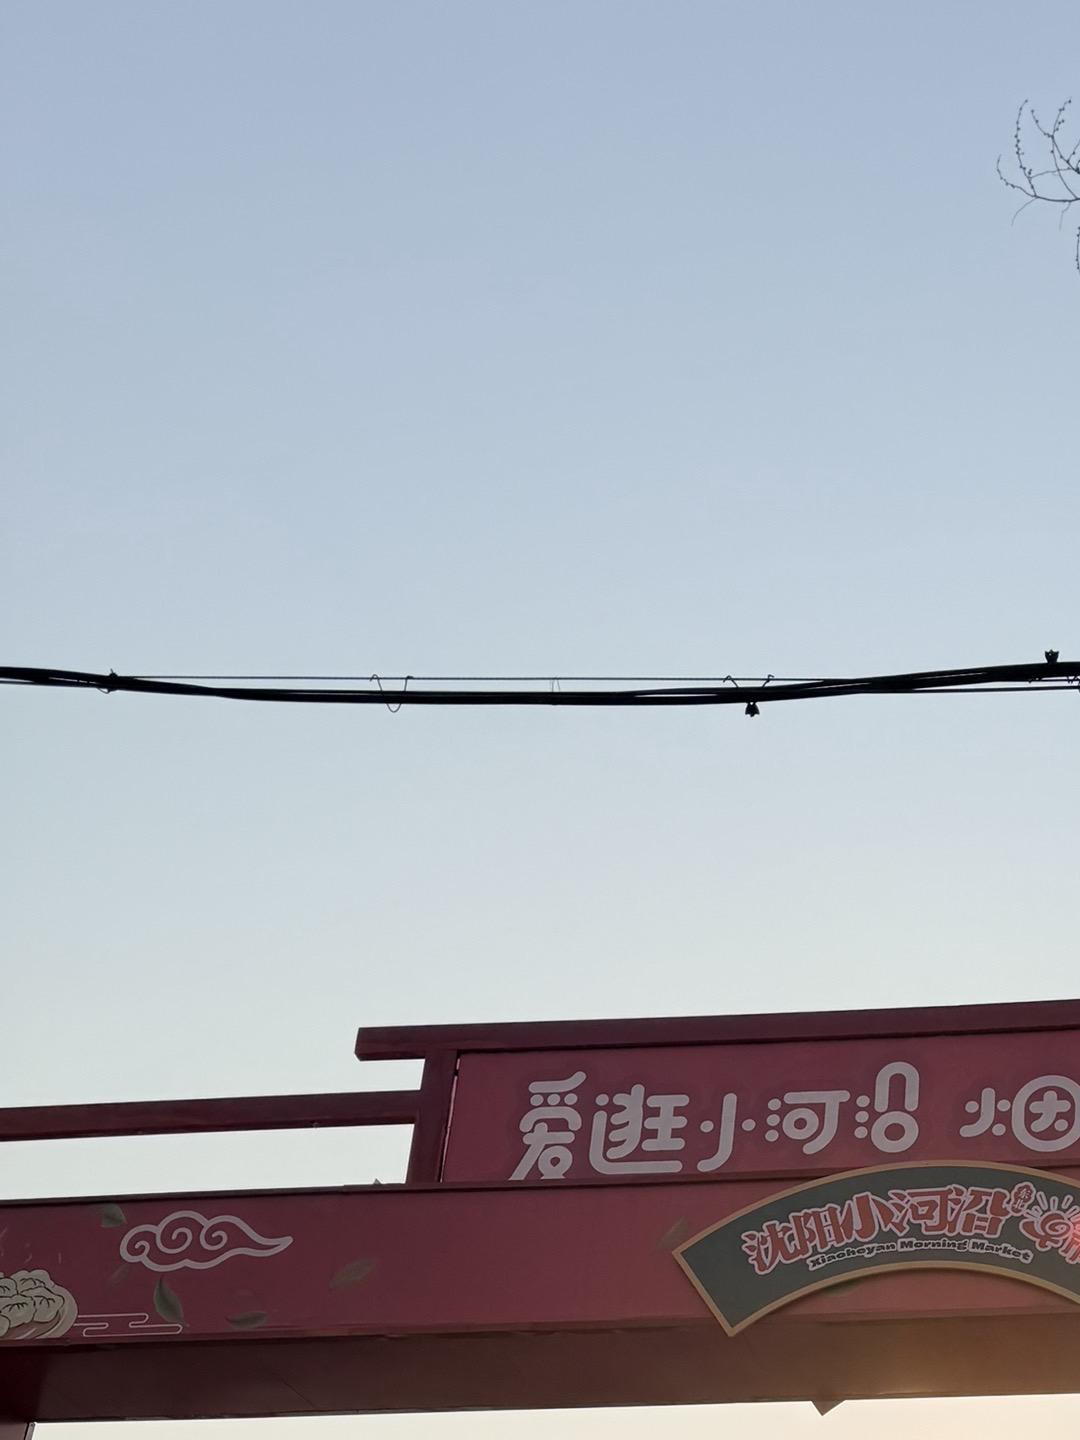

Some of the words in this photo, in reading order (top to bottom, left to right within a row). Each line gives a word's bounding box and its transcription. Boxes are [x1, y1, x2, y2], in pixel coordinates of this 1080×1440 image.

[509, 1061, 920, 1181] 爱逛小河沿
[899, 1239, 968, 1251] Morning
[971, 1240, 1033, 1263] Market
